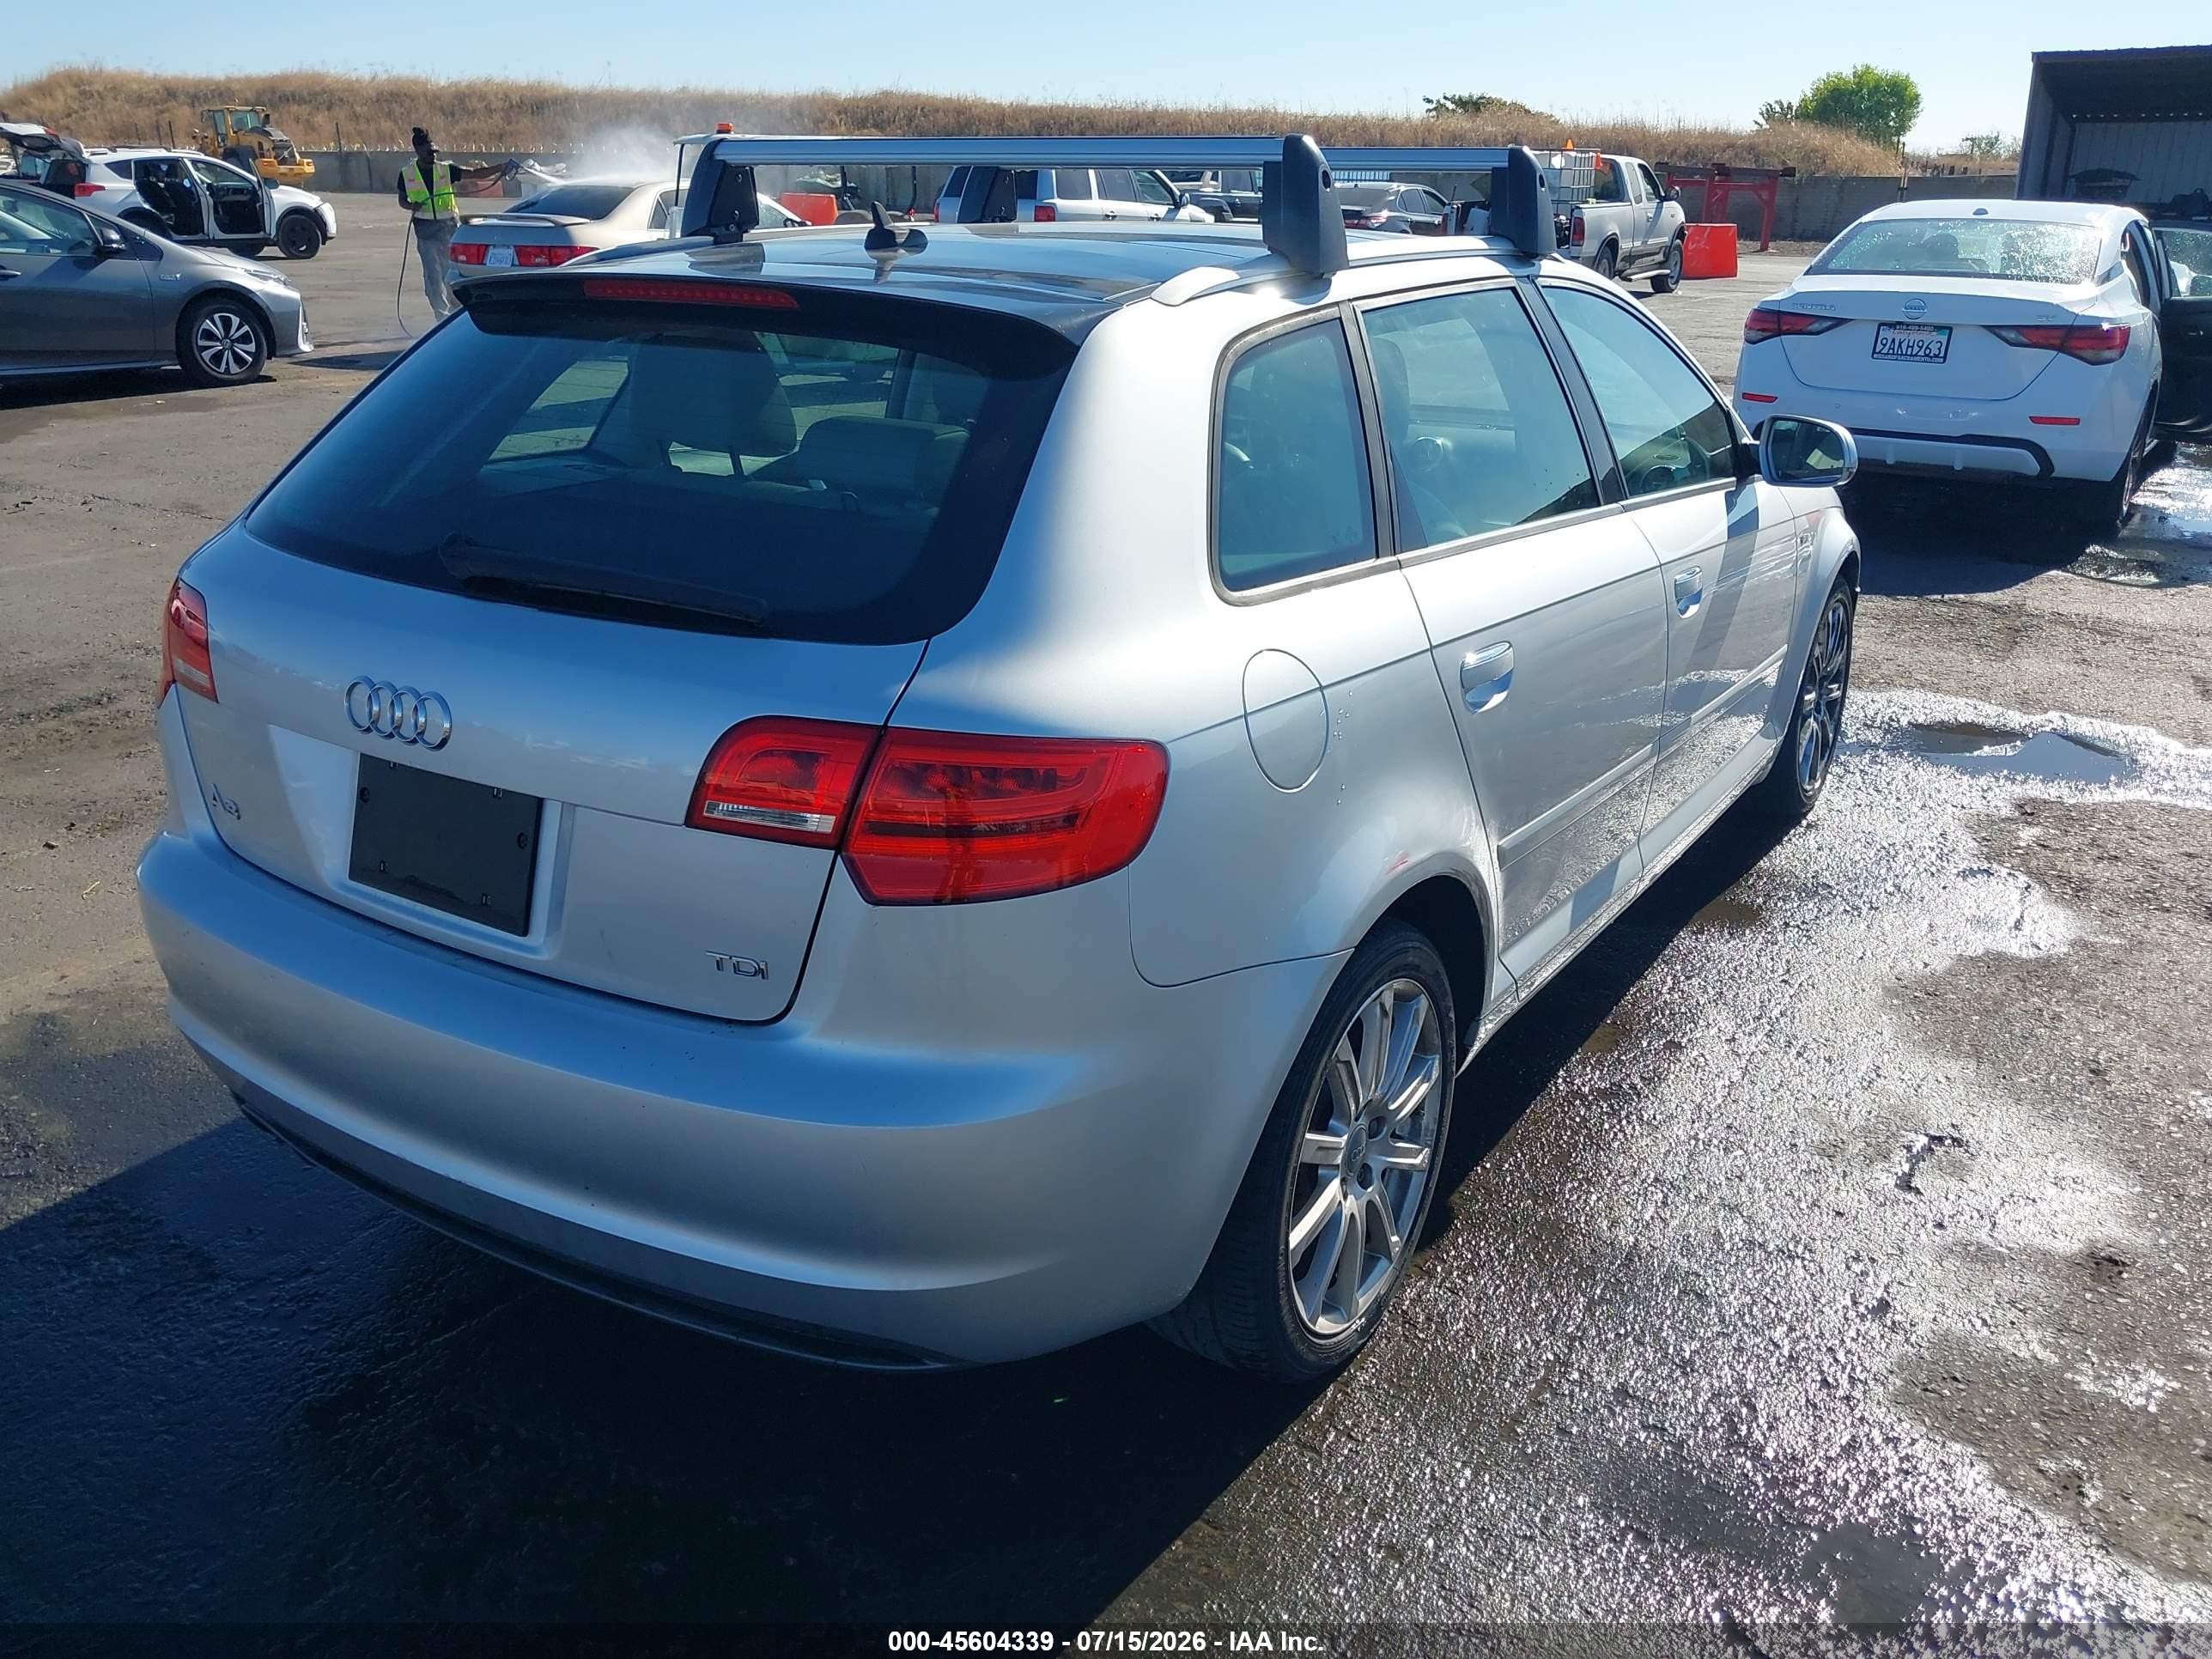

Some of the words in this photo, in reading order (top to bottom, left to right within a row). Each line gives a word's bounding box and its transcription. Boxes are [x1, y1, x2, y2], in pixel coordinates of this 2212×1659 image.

[1876, 337, 1943, 357] 9AKH963
[212, 782, 241, 821] A3
[705, 950, 769, 981] TDI
